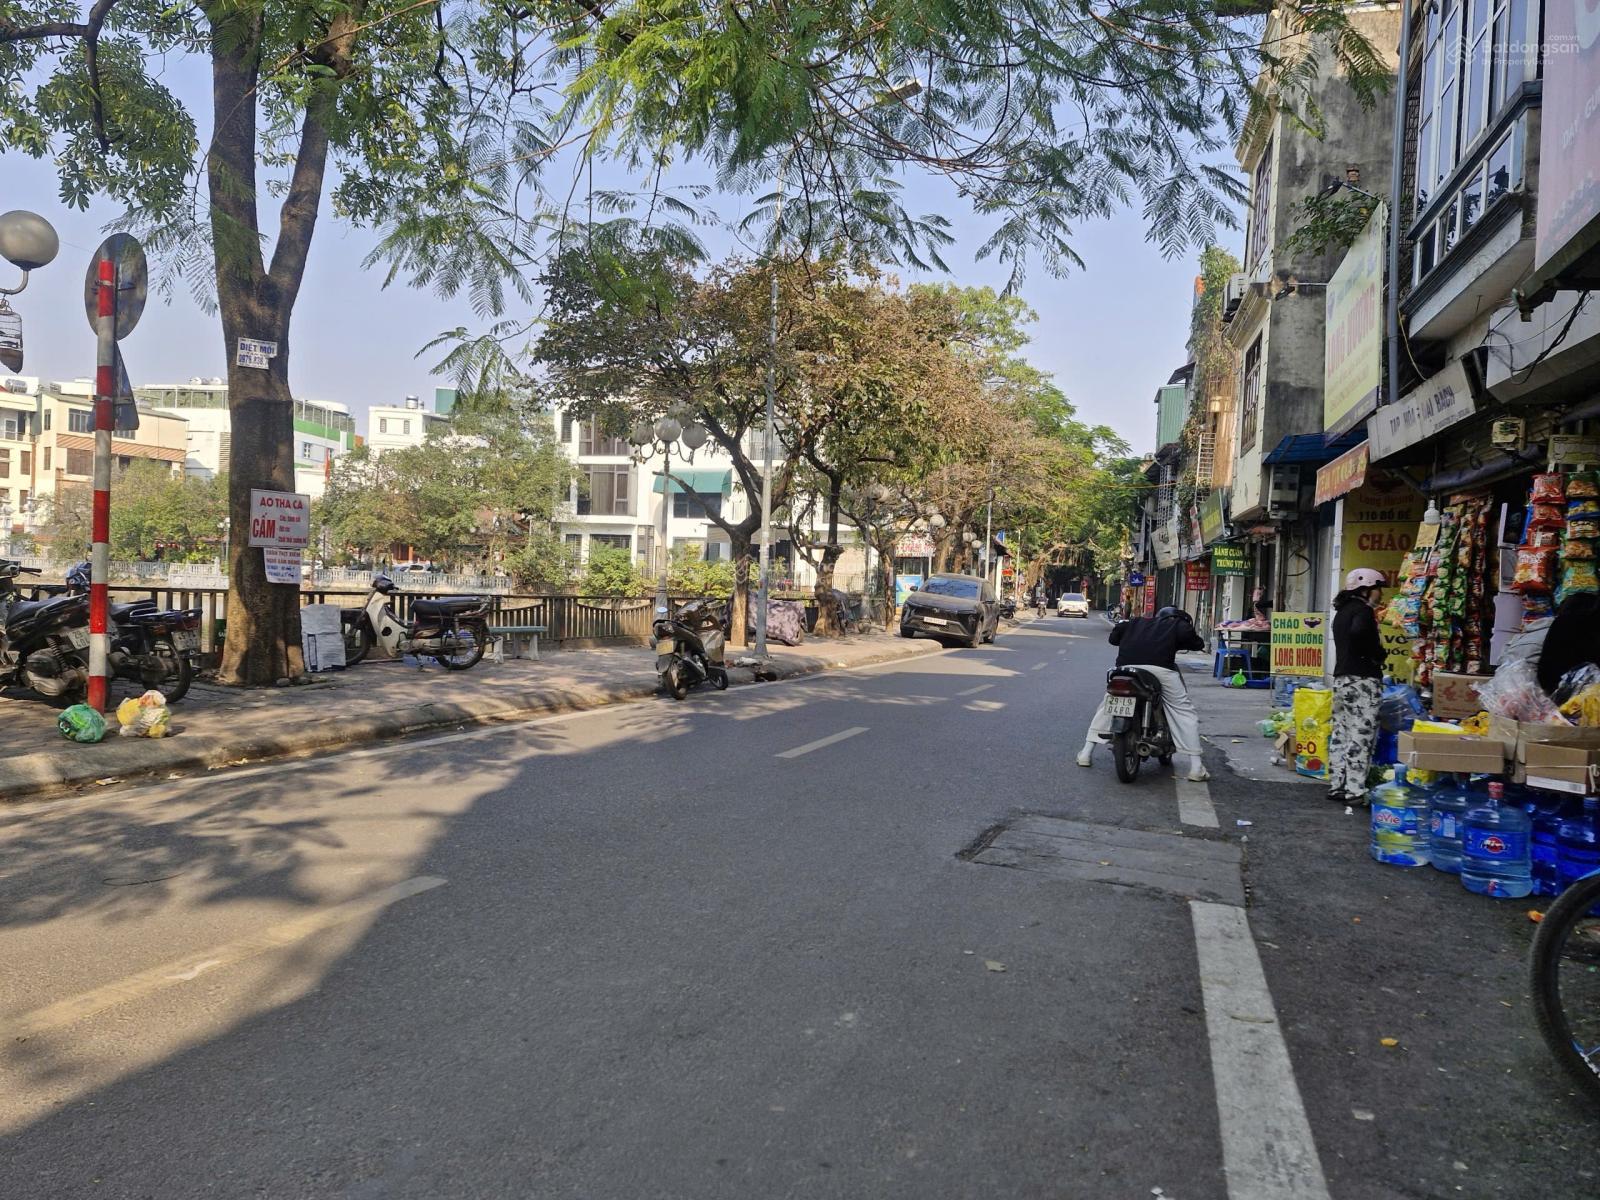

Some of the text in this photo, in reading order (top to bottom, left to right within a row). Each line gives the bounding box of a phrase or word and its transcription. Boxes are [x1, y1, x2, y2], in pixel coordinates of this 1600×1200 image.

[252, 512, 276, 539] CẤM
[1358, 530, 1411, 551] CHÁO
[1273, 616, 1300, 629] CHÁO
[1273, 631, 1323, 645] DINH DƯỠNG
[1274, 648, 1294, 667] LONG
